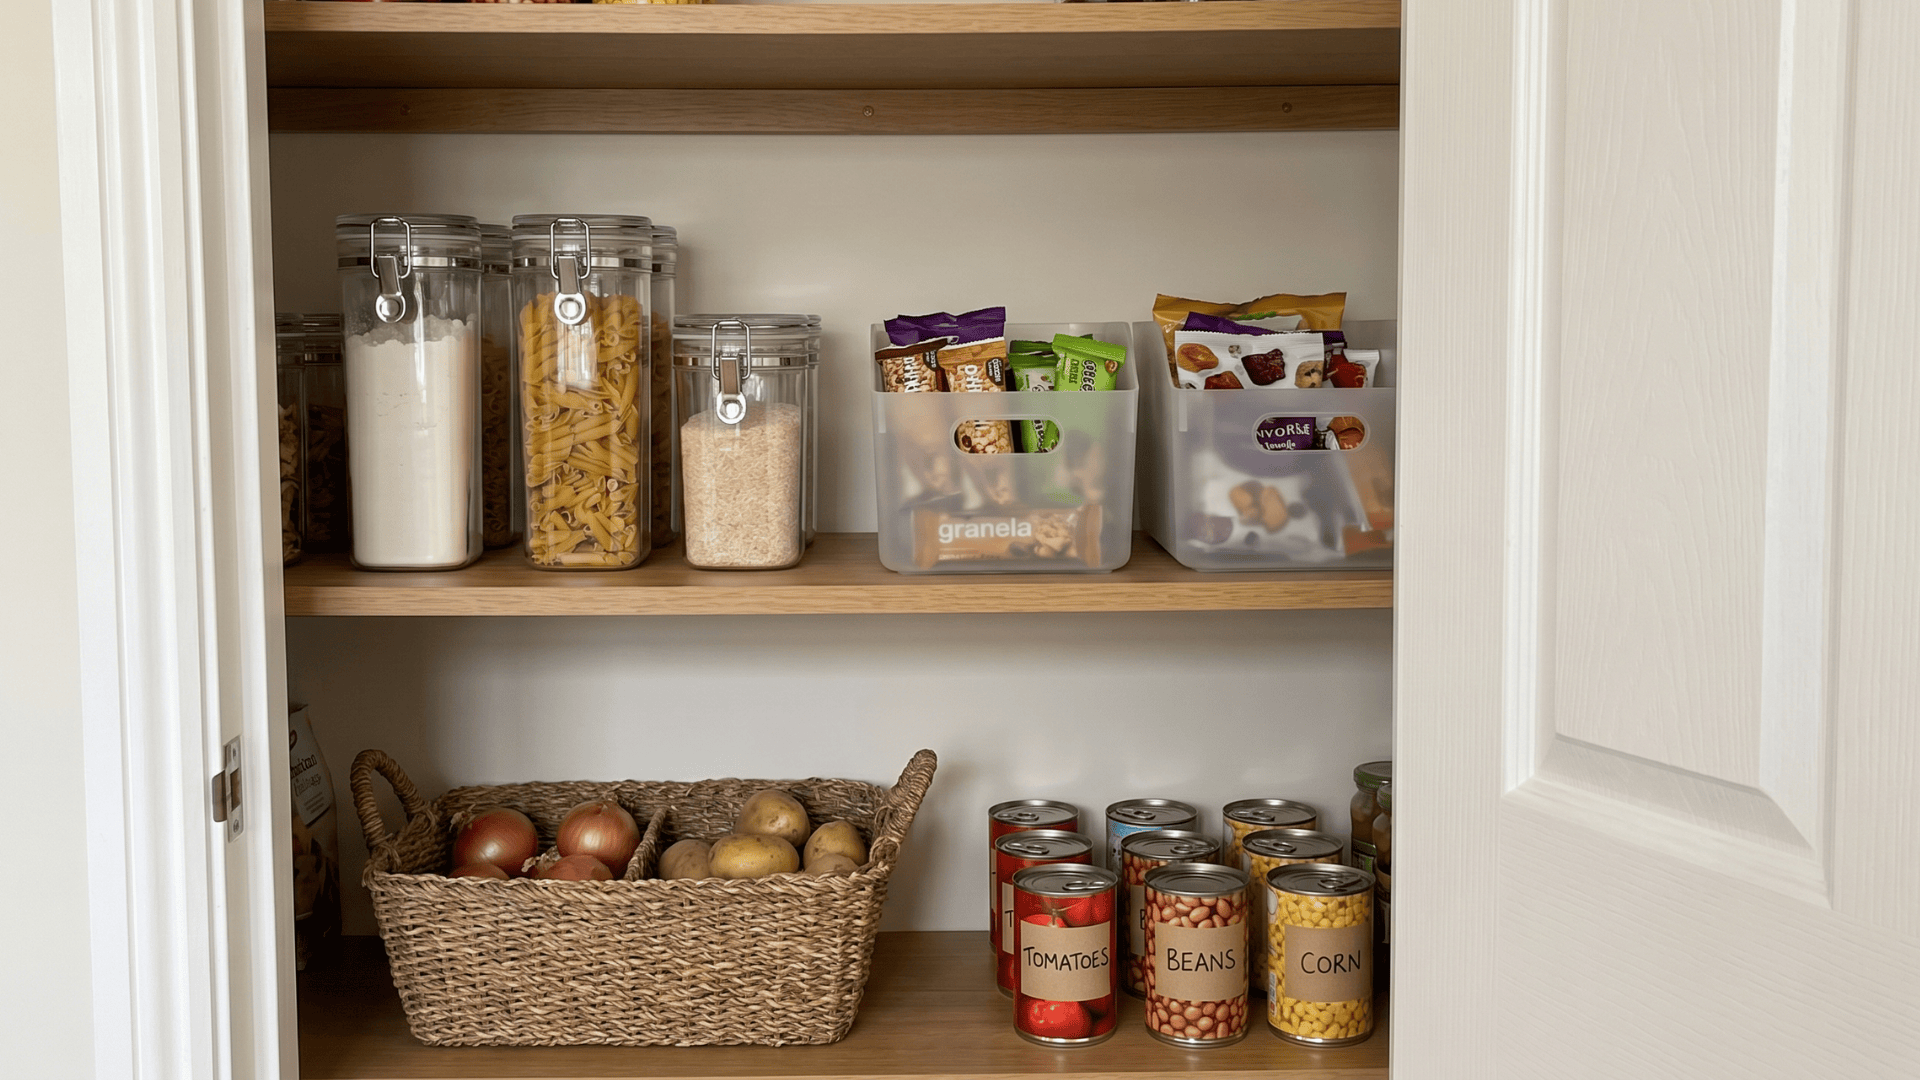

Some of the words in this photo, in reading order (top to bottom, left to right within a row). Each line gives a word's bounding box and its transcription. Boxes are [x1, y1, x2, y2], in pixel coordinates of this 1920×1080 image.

[938, 517, 1032, 544] granela
[1023, 946, 1109, 972] TOMATOES
[1166, 948, 1236, 972] BEANS
[1300, 950, 1361, 975] CORN
